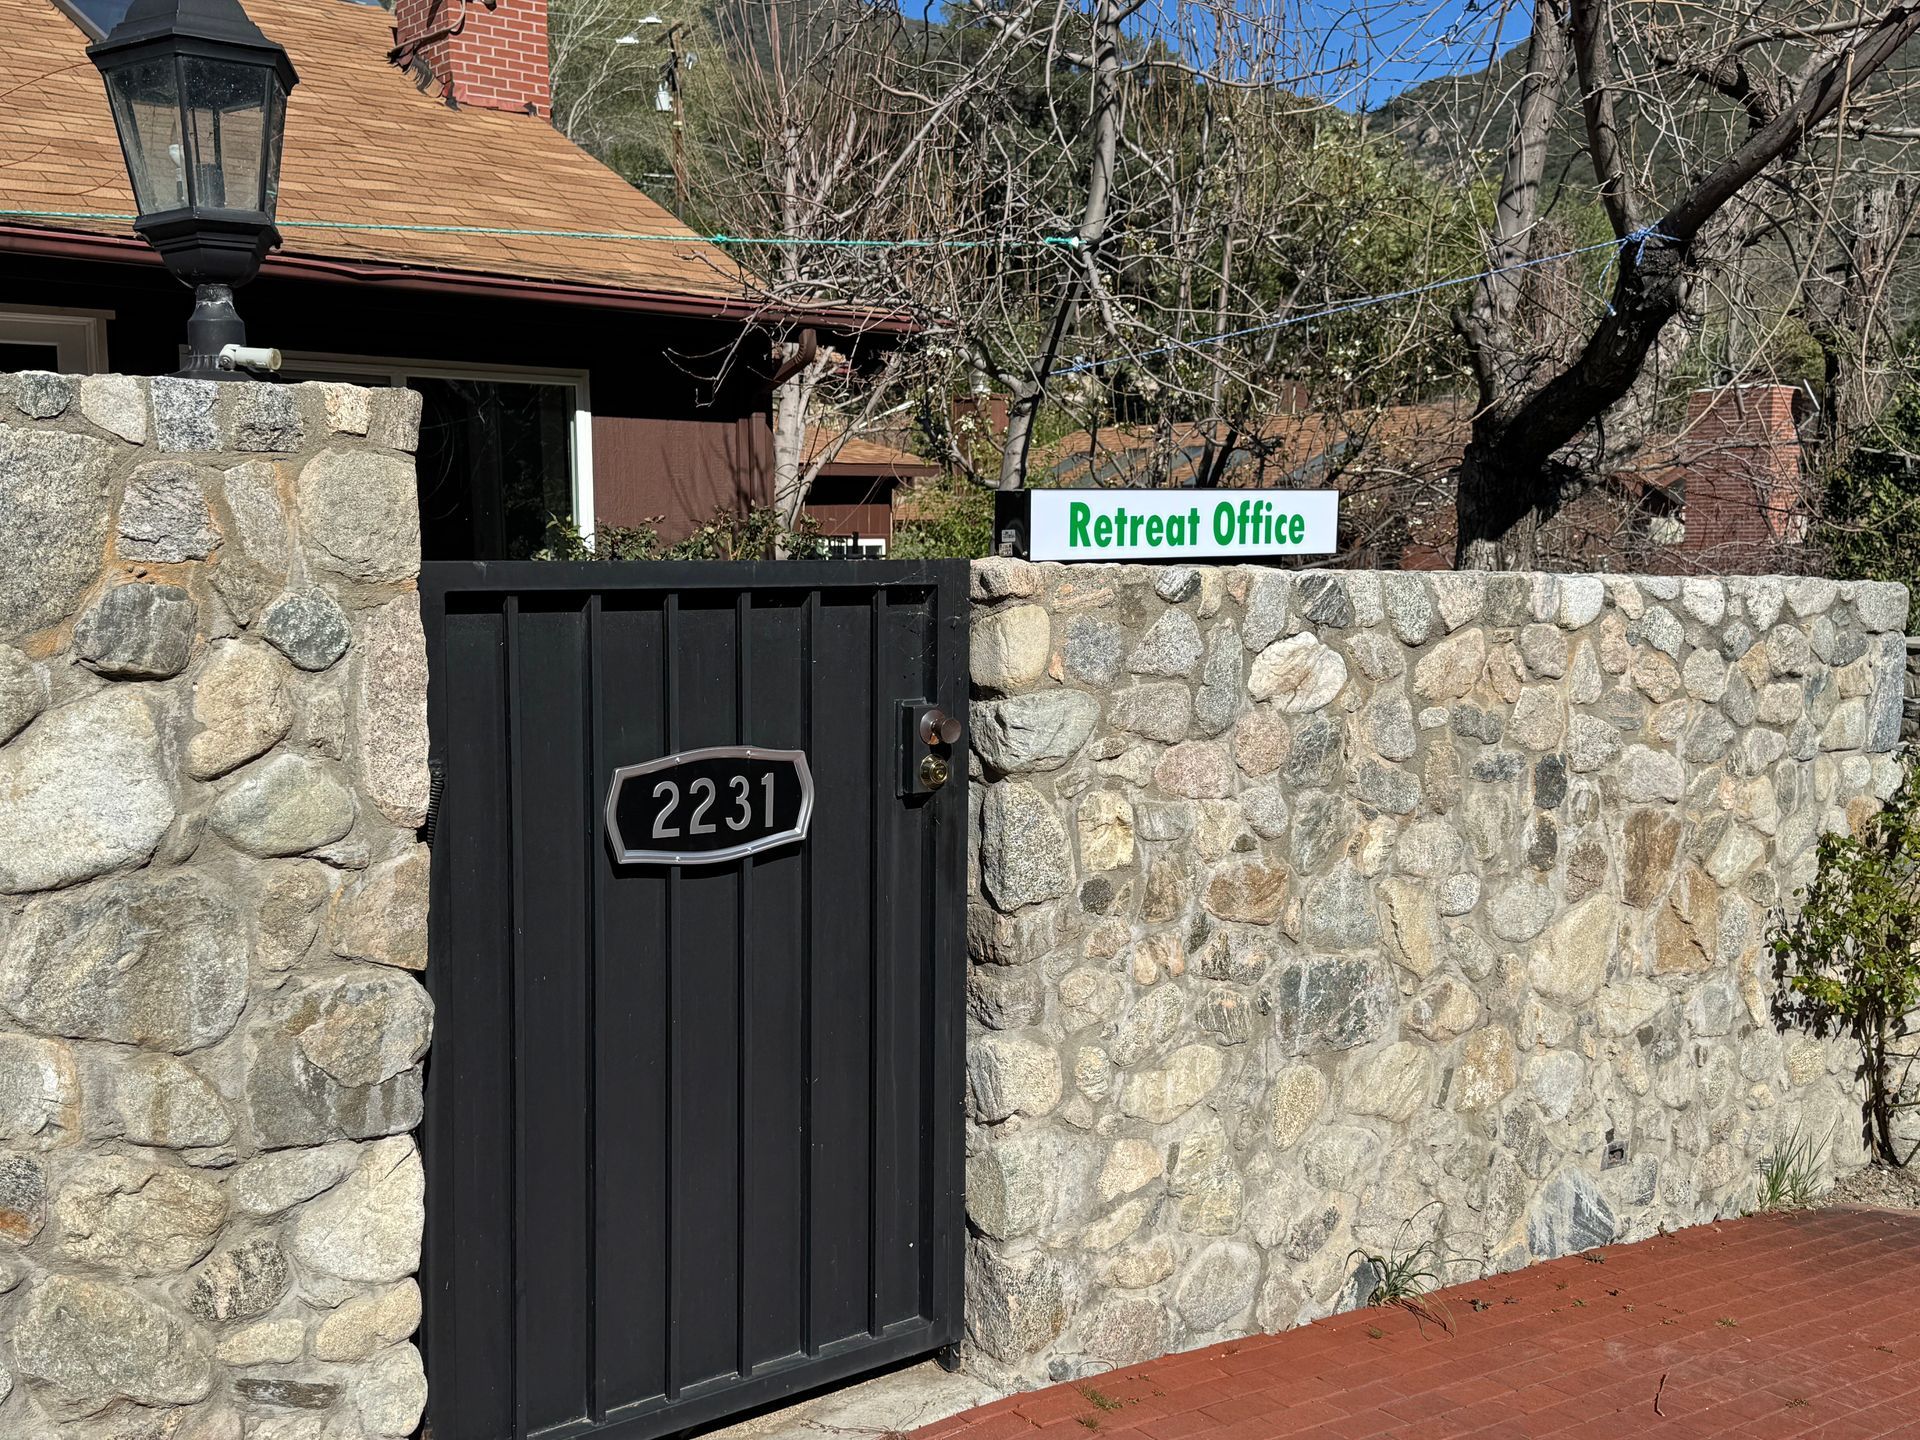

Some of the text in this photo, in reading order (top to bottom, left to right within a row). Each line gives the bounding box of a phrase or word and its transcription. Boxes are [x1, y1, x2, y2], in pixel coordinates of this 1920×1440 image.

[1069, 500, 1305, 548] Retreat Office
[652, 772, 774, 839] 2231
